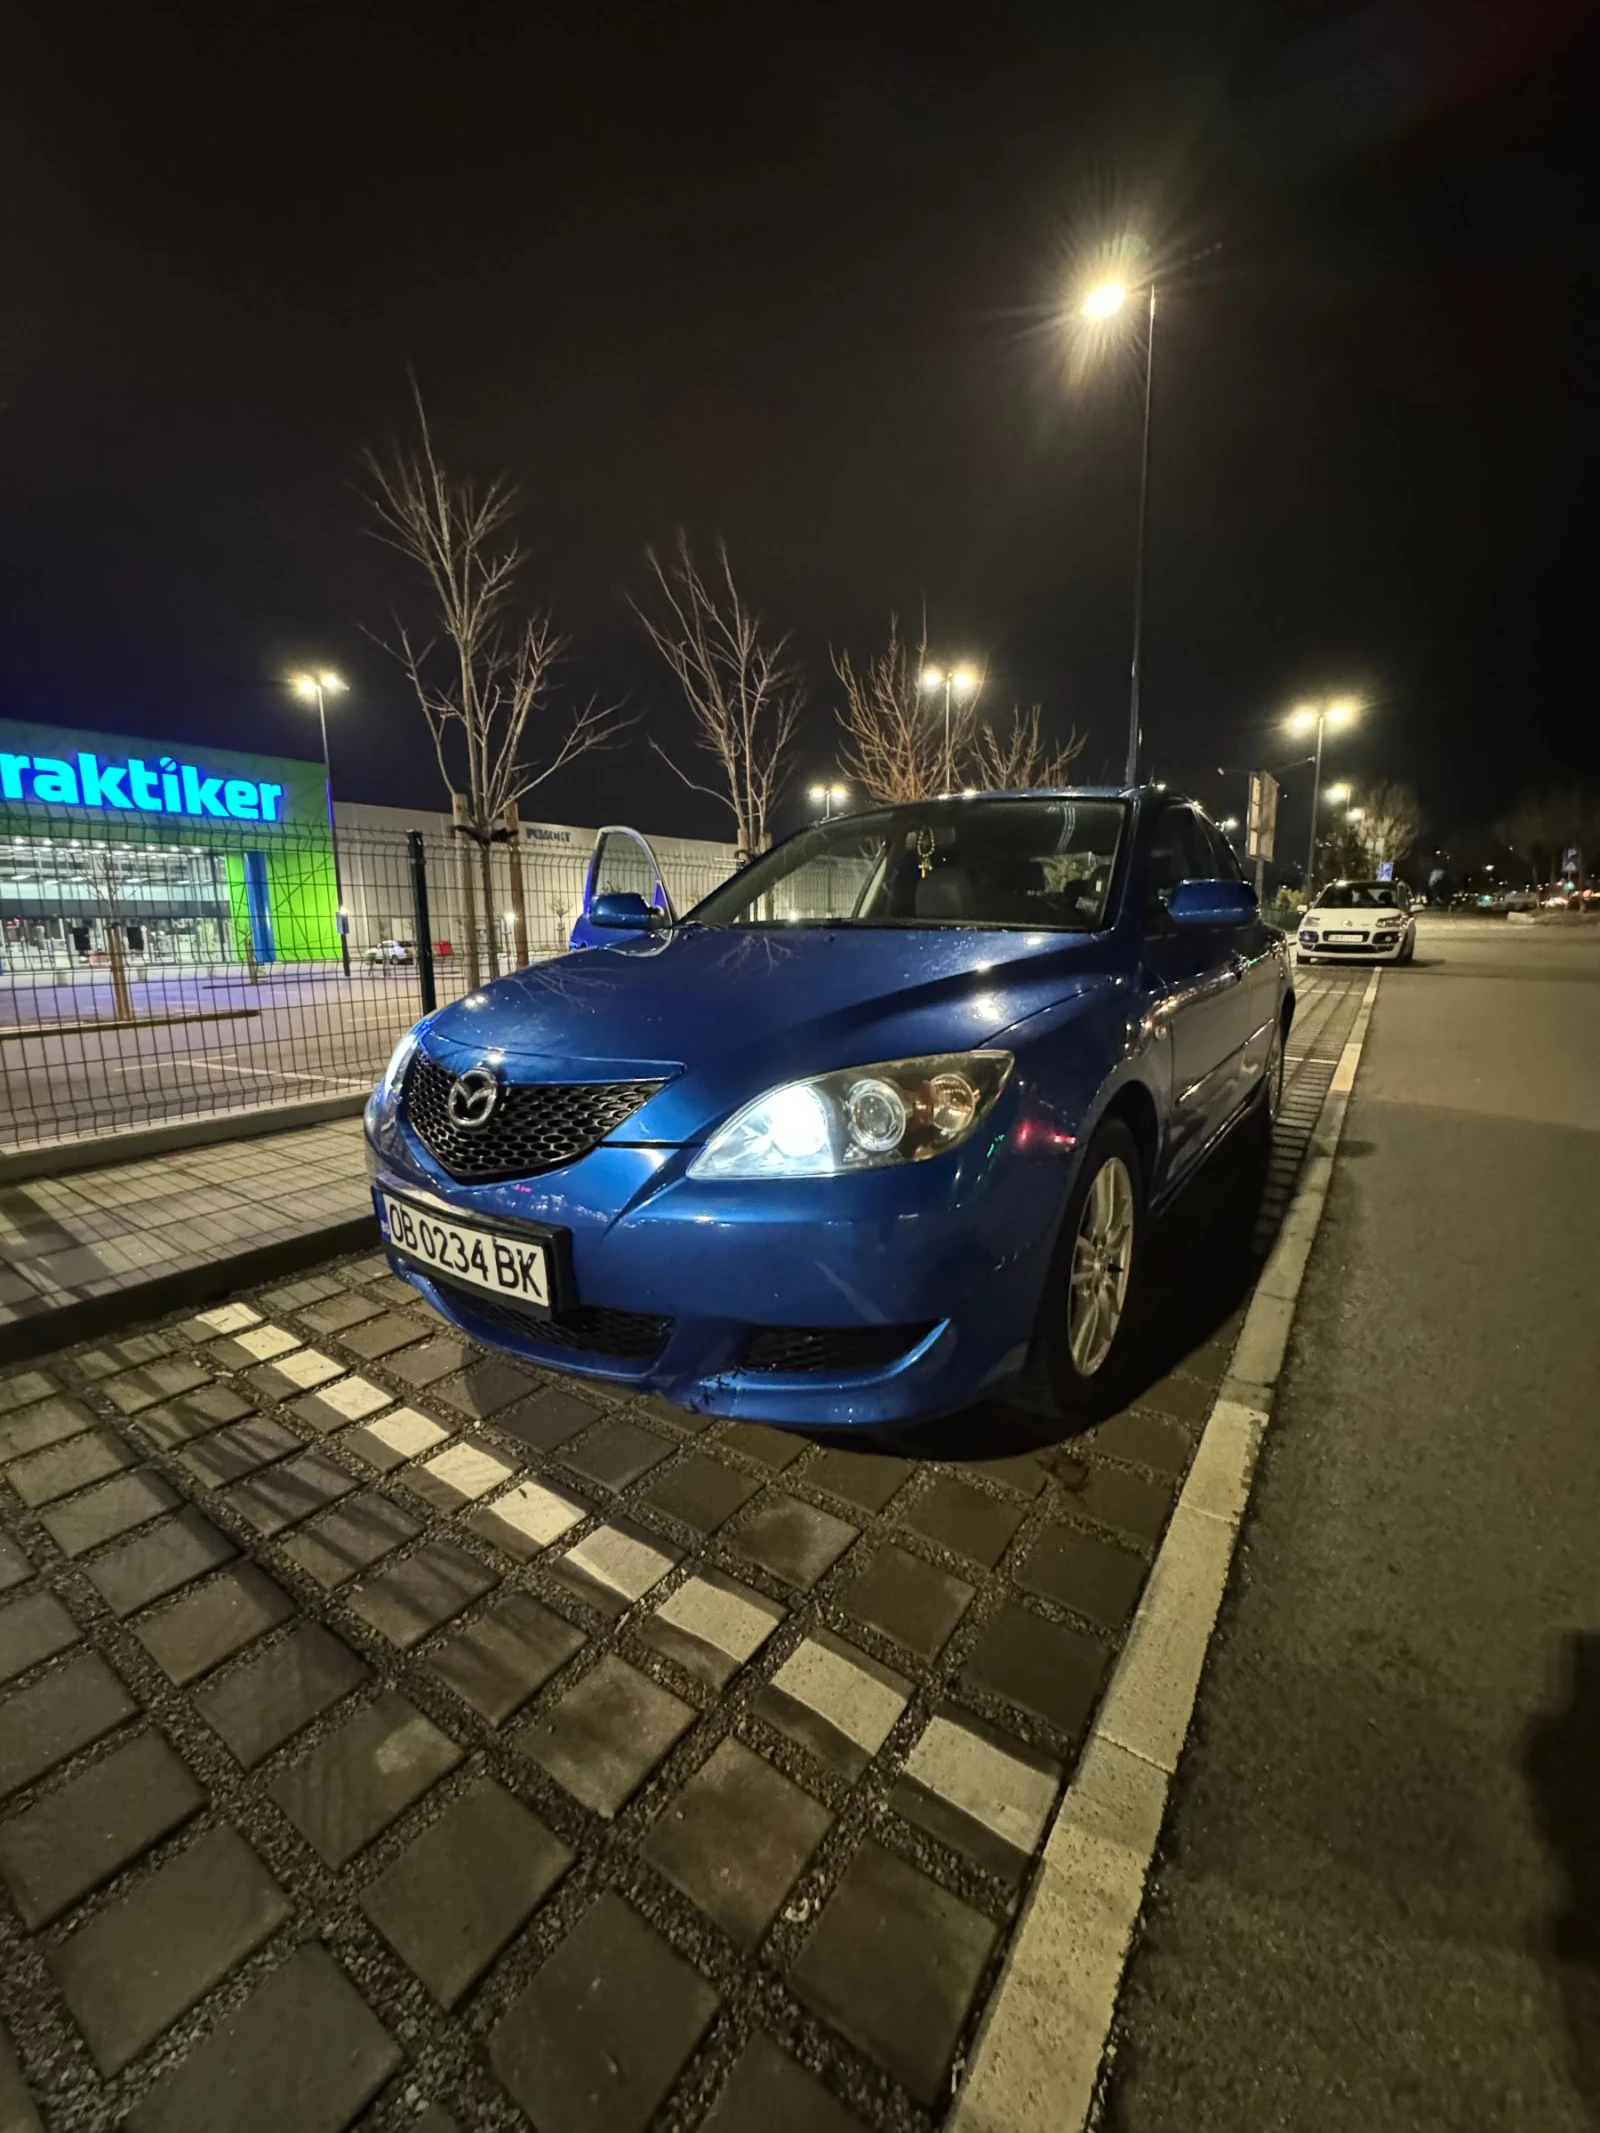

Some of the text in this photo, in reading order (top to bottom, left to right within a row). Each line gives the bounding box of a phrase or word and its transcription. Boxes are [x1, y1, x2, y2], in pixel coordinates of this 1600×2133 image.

[0, 752, 283, 822] raktiker
[389, 1203, 542, 1298] OB 0234 BK
